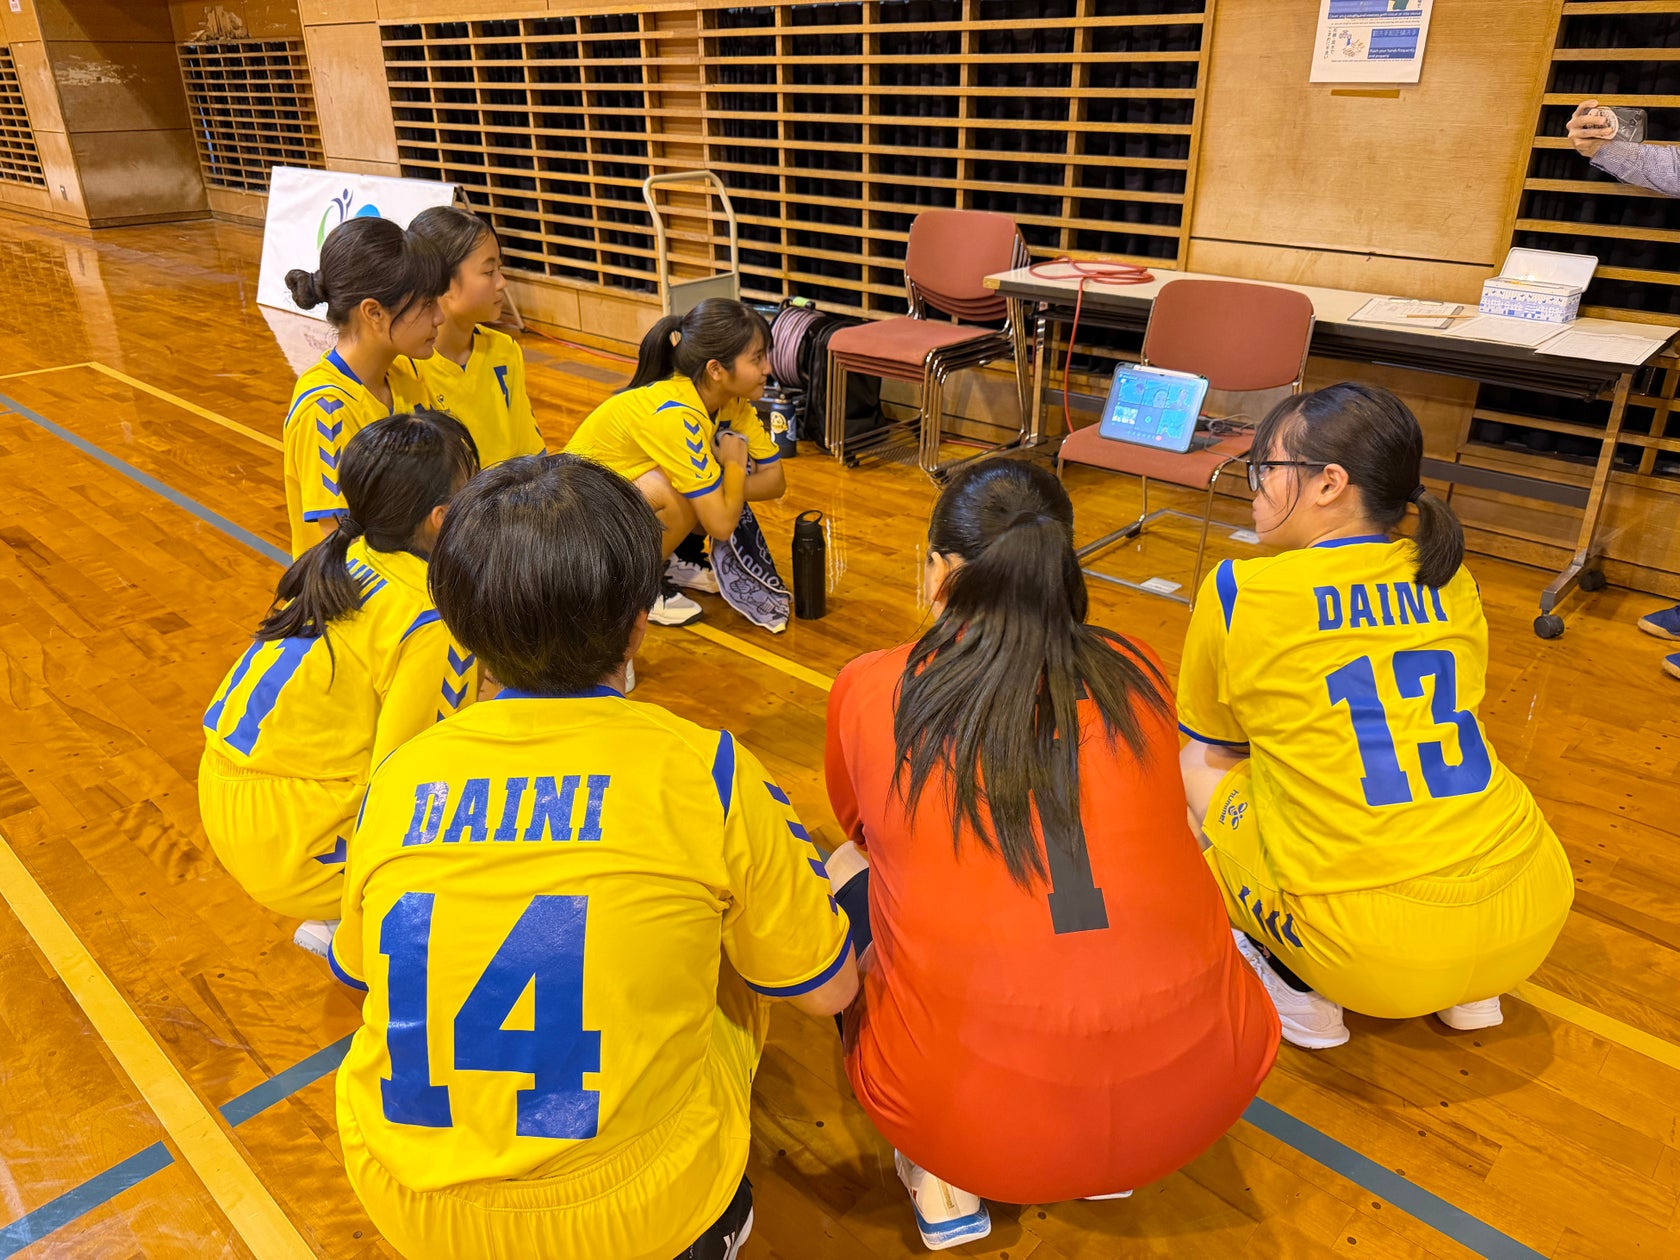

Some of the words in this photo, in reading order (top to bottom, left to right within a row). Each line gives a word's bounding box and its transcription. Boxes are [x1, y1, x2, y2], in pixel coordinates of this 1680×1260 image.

[1313, 582, 1448, 631] DAINI
[203, 625, 322, 756] 11
[1325, 650, 1492, 806] 13
[402, 775, 610, 847] DAINI
[379, 892, 601, 1139] 14
